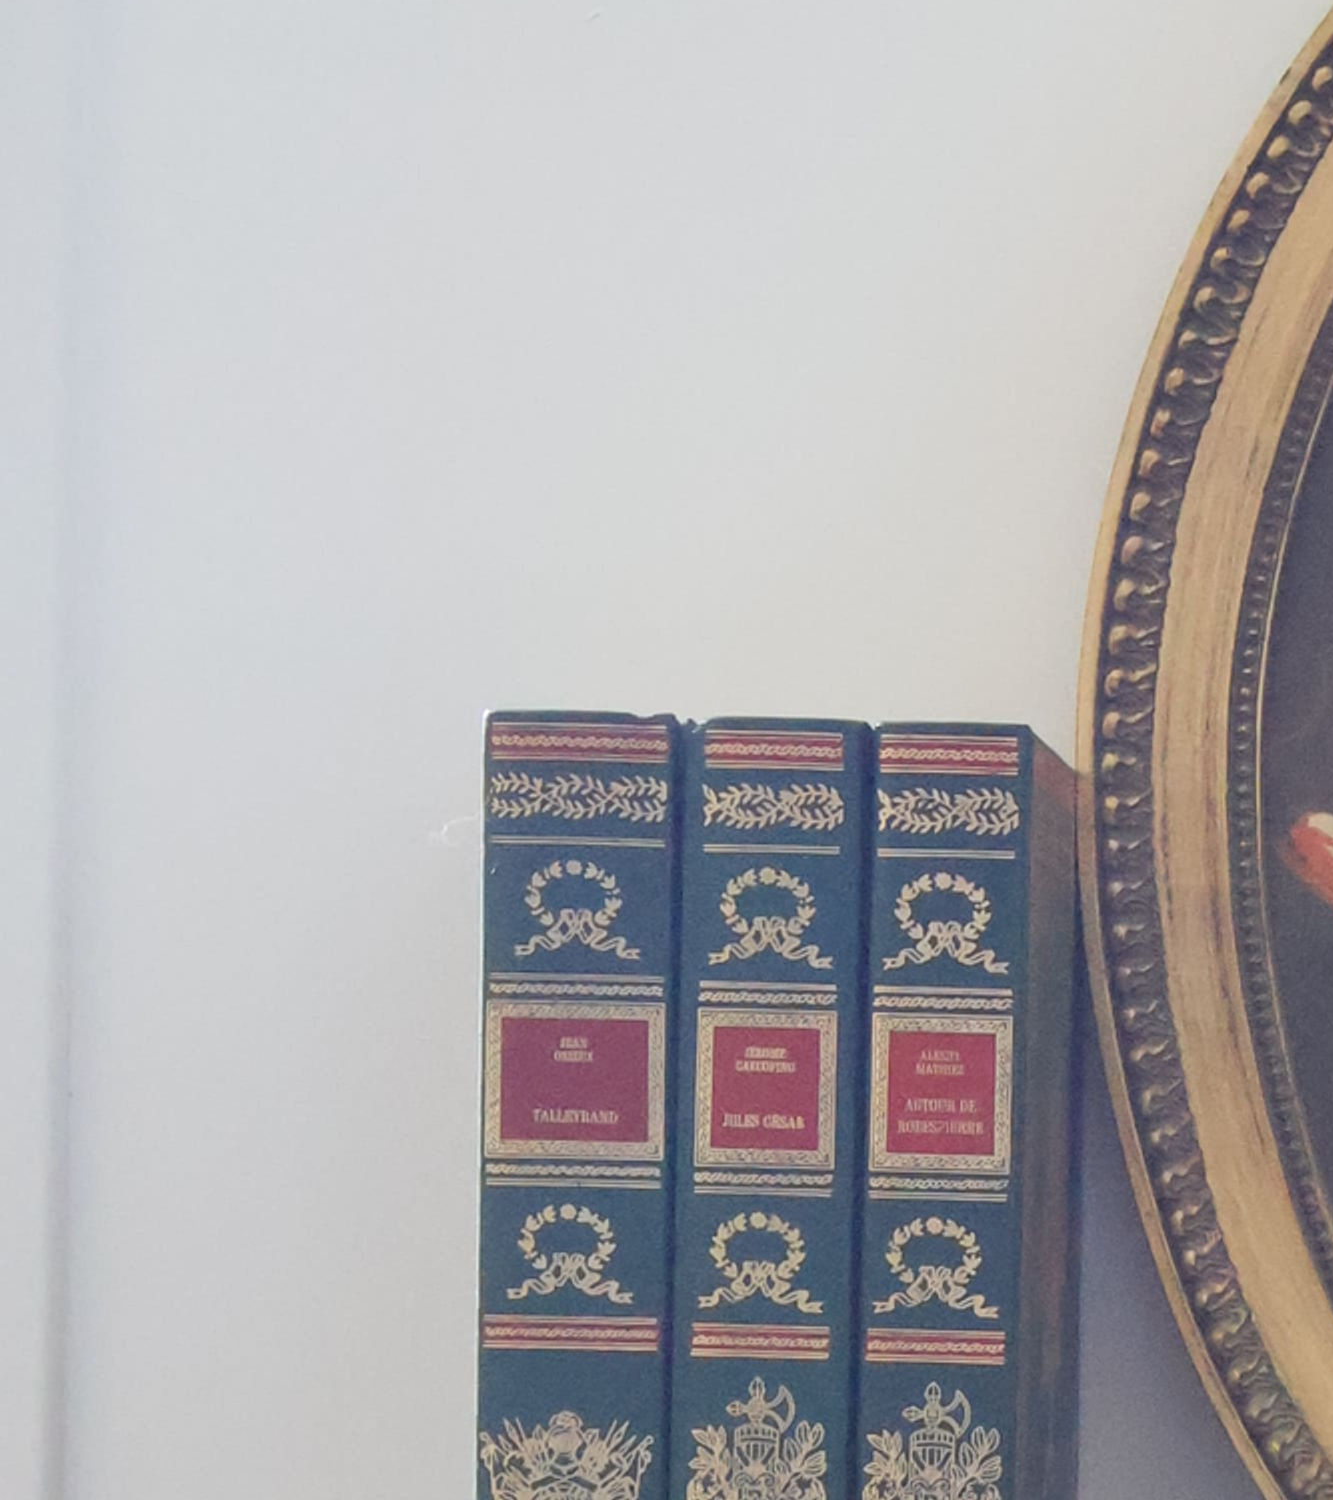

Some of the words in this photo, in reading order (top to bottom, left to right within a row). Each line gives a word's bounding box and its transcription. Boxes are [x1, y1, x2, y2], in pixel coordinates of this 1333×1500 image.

[960, 1099, 977, 1113] DE
[533, 1108, 619, 1124] TALLEYRAND
[722, 1112, 760, 1128] JULES
